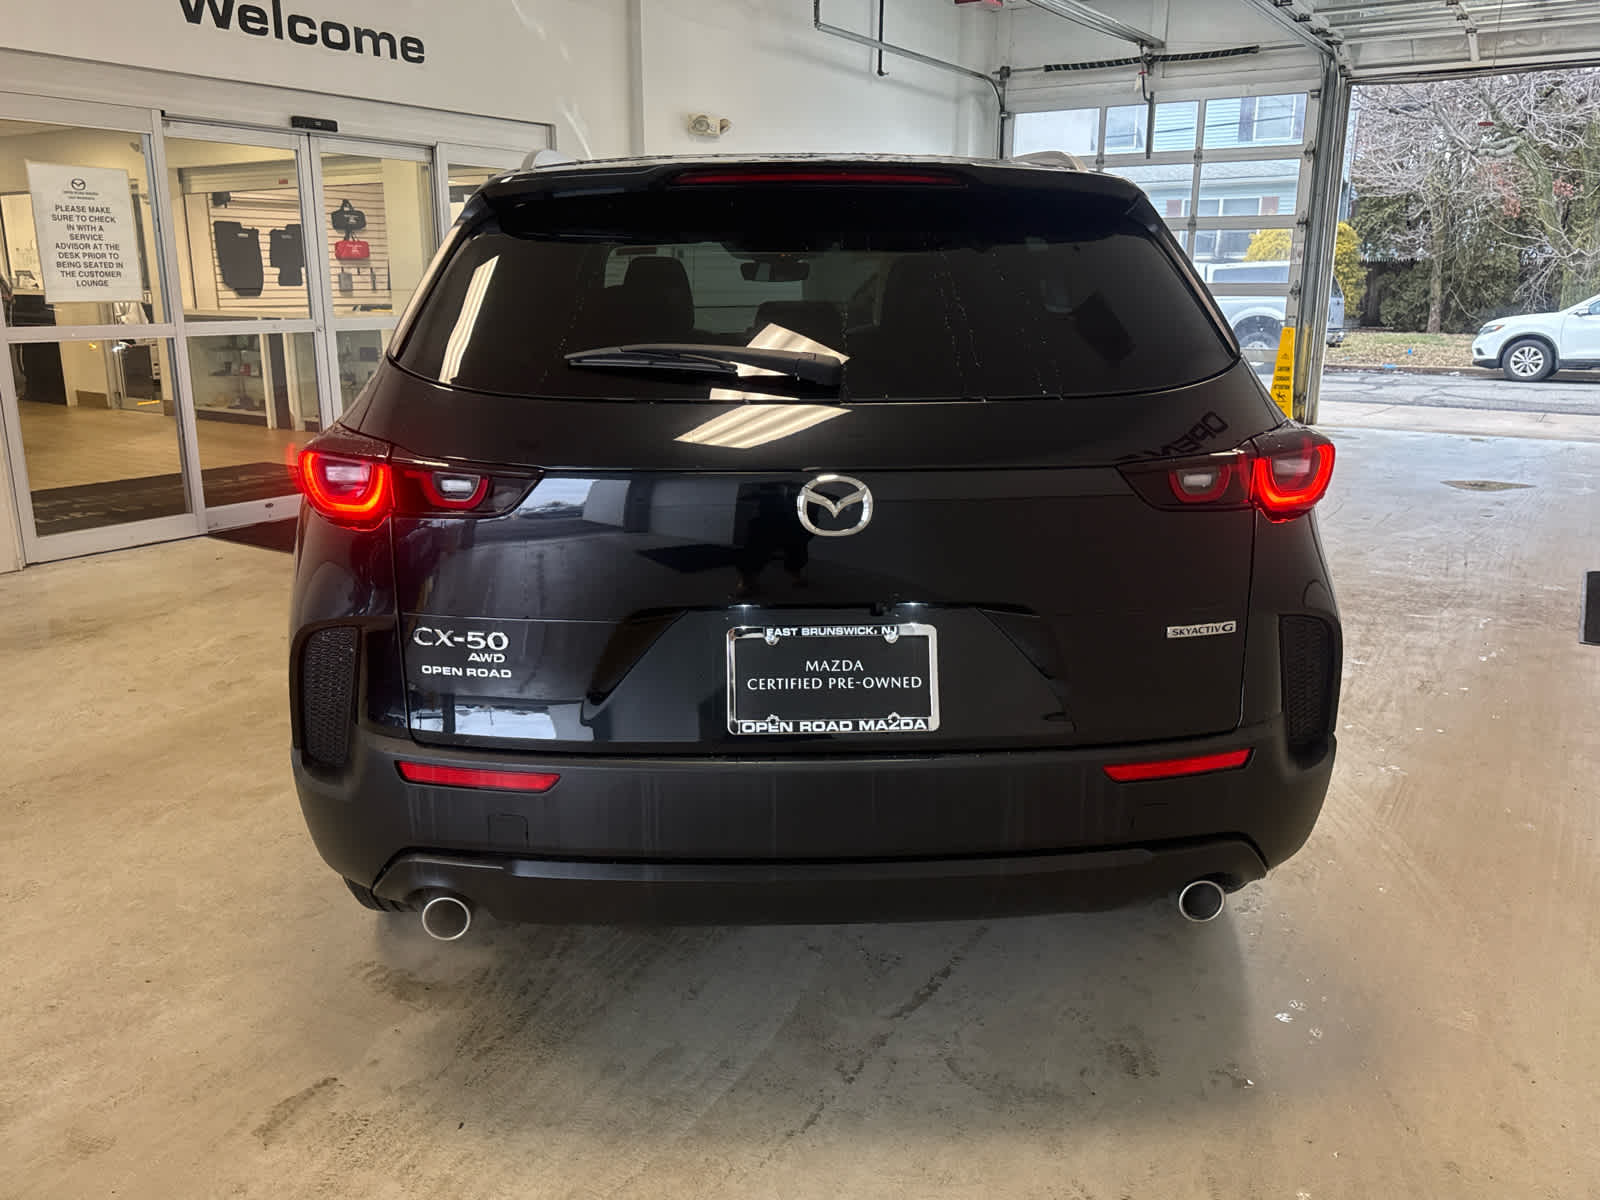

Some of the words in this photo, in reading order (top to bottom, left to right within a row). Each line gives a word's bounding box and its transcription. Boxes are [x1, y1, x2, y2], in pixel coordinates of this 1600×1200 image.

[179, 0, 425, 64] Welcome
[55, 204, 87, 213] PLEASE
[89, 205, 111, 214] MAKE
[51, 214, 74, 222] SURE
[75, 214, 87, 223] TO
[88, 215, 117, 223] CHECK
[76, 224, 97, 232] WITH
[69, 233, 104, 241] SERVICE
[55, 242, 92, 250] ADVISOR
[93, 243, 103, 251] AT
[105, 243, 120, 251] THE
[58, 251, 80, 259] DESK
[82, 252, 107, 260] PRIOR
[109, 252, 120, 260] TO
[56, 261, 82, 269] BEING
[83, 261, 114, 269] SEATED
[116, 261, 124, 269] IN
[60, 270, 76, 278] THE
[78, 270, 122, 278] CUSTOMER
[76, 279, 109, 287] LOUNGE
[766, 627, 798, 637] EAST
[801, 626, 878, 636] BRUNSWICK,
[881, 626, 898, 636] NJ
[413, 627, 509, 650] CX-50
[468, 653, 505, 663] AWD
[805, 660, 864, 672] MAZDA
[421, 665, 462, 676] OPEN
[466, 668, 512, 678] ROAD
[747, 678, 823, 690] CERTIFIED
[828, 676, 922, 689] PRE-OWNED
[741, 722, 793, 733] OPEN
[799, 721, 852, 732] ROAD
[859, 719, 927, 731] MAZDA
